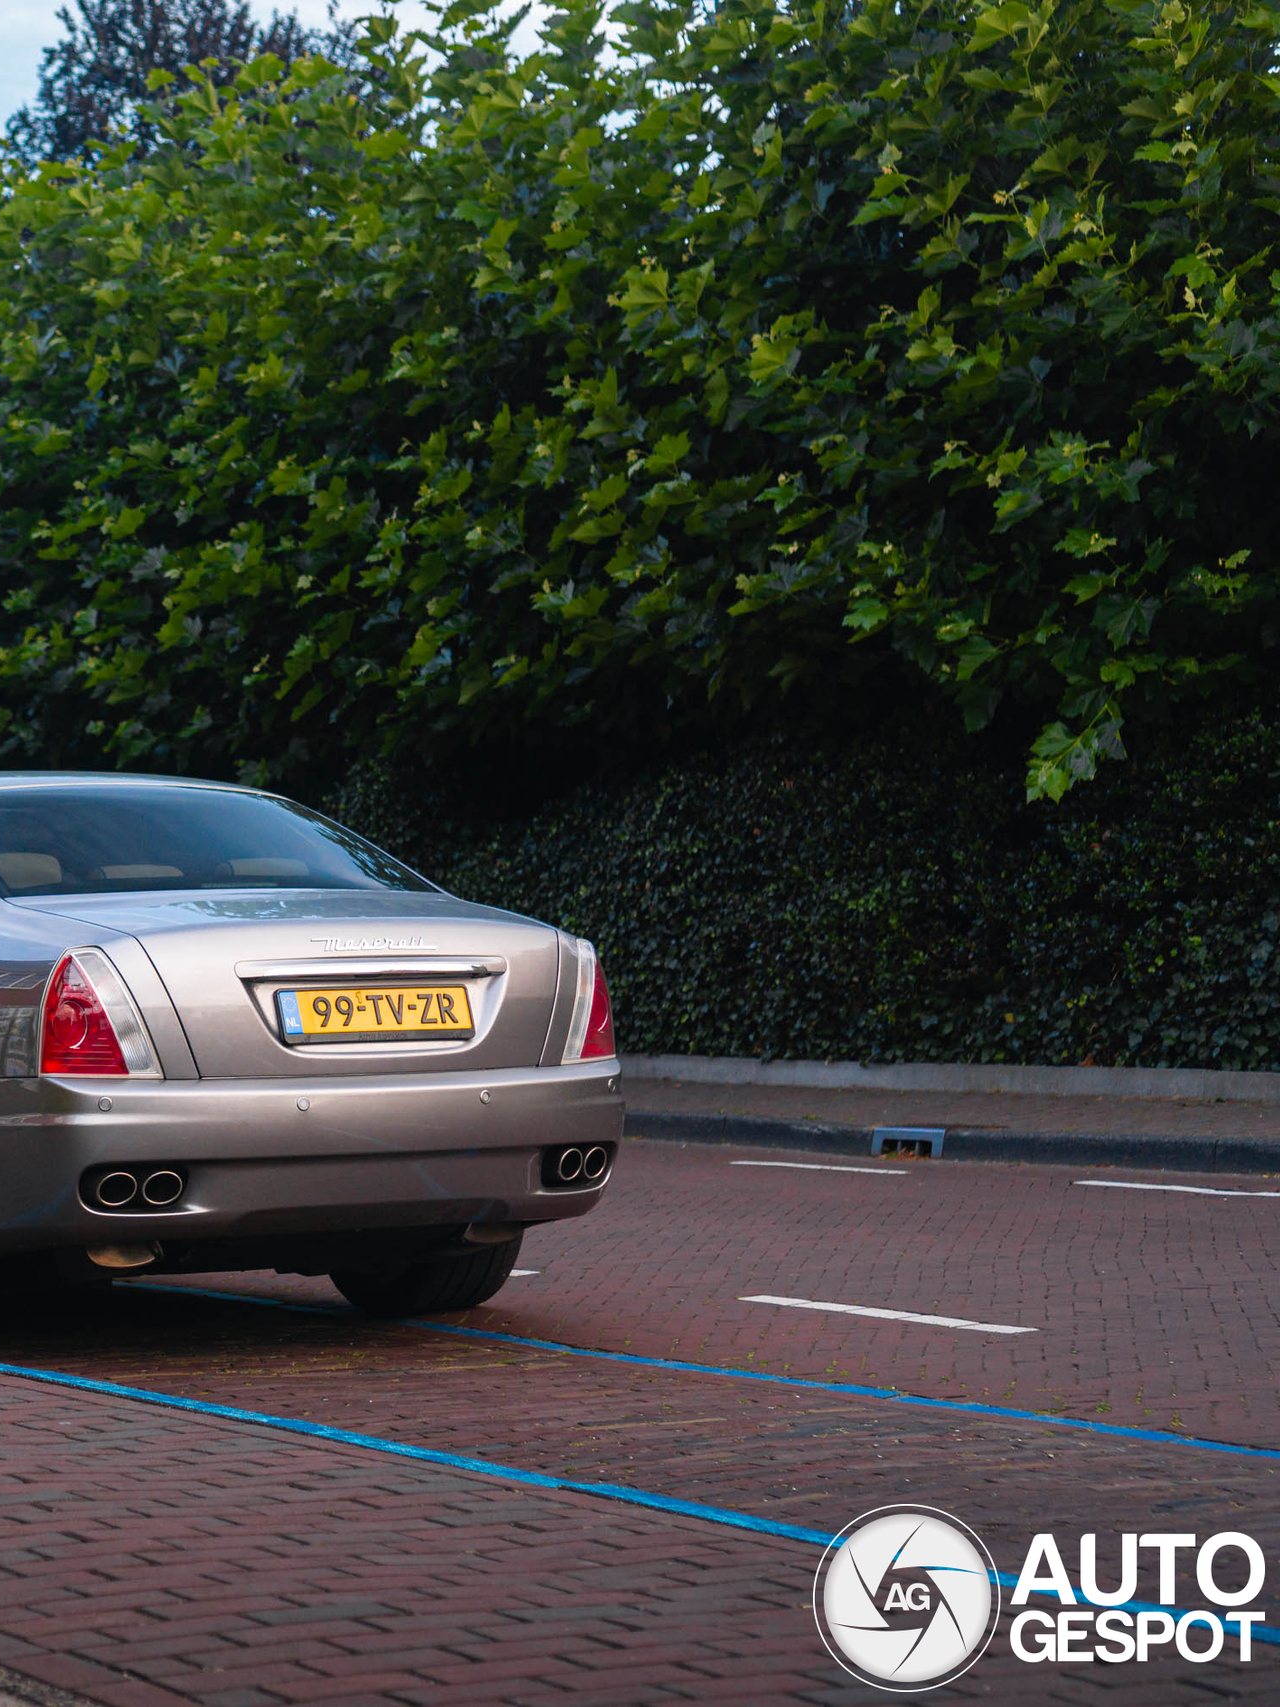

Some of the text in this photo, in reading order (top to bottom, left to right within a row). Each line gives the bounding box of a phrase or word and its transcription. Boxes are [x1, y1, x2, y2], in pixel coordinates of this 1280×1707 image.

[310, 936, 438, 952] Maserati
[312, 993, 459, 1028] 99-TV-ZR
[285, 1017, 300, 1028] NL
